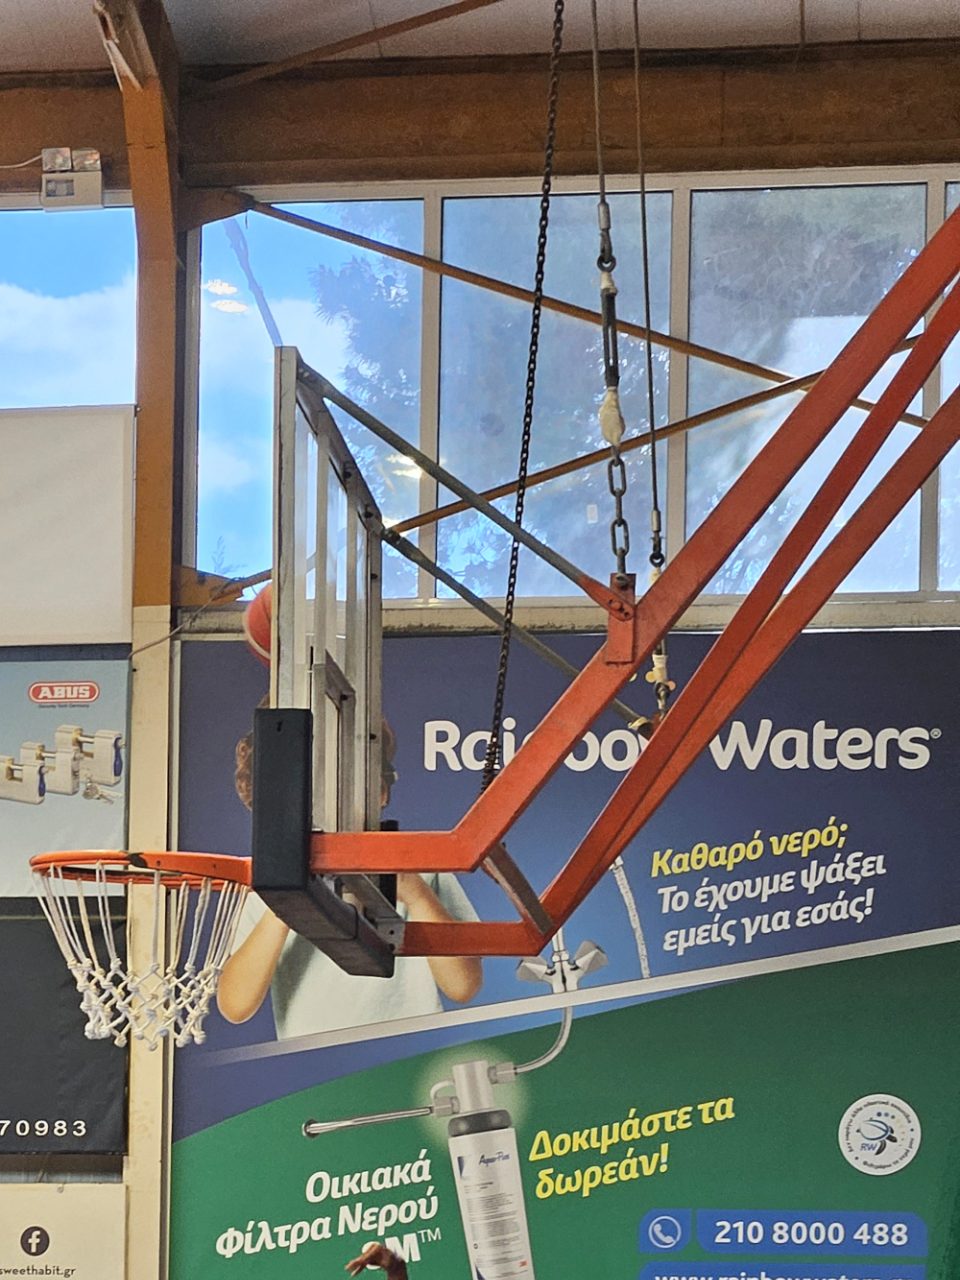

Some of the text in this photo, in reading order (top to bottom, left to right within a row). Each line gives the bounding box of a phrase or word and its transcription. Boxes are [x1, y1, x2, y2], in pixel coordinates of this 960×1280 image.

[38, 686, 90, 699] ABUS
[651, 816, 848, 878] Καθαρό νερό;
[657, 851, 886, 913] Το έχουμε ψάξει
[663, 888, 875, 956] εμείς για εσάς!
[529, 1096, 735, 1162] Δοκιμάστε τα
[305, 1149, 431, 1203] Οικιακά
[535, 1143, 669, 1199] δωρεάν!
[215, 1217, 331, 1258] Φίλτρα
[338, 1186, 438, 1236] Νερού
[714, 1221, 908, 1246] 210 8000 488
